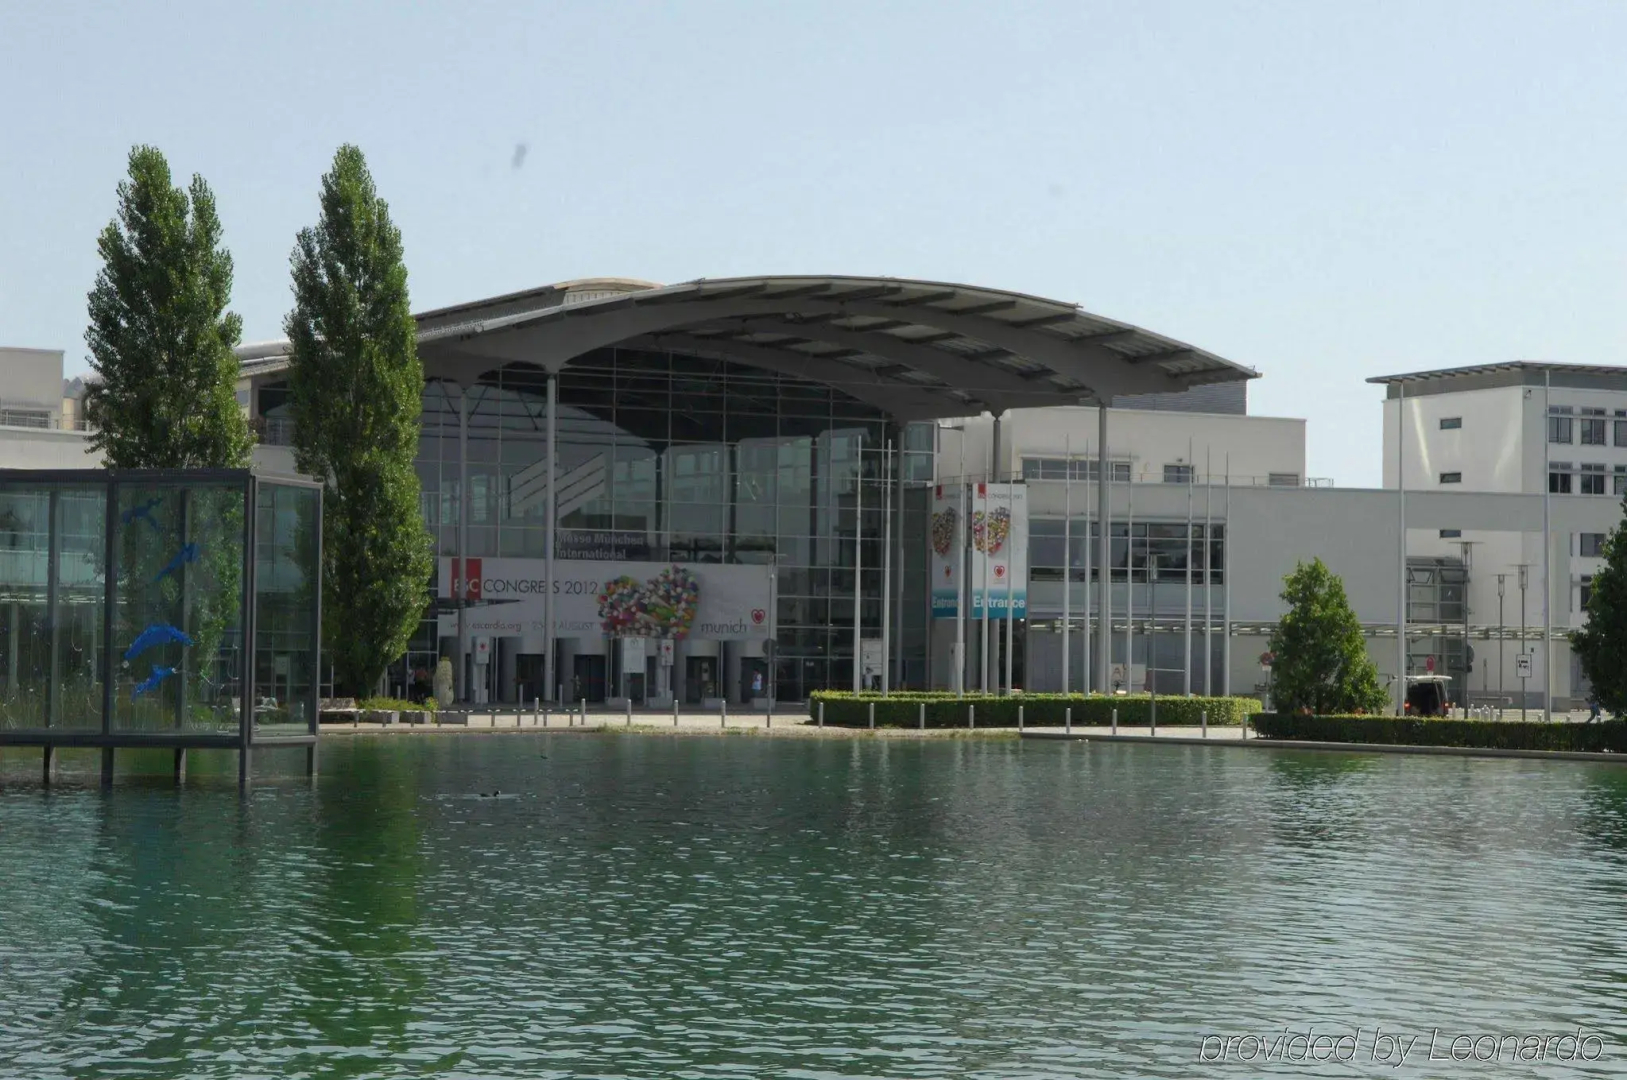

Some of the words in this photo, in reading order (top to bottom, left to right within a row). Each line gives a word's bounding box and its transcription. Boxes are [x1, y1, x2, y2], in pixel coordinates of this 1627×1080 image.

[483, 578, 560, 594] CONGRES
[564, 580, 598, 595] 2012
[701, 617, 748, 634] munich
